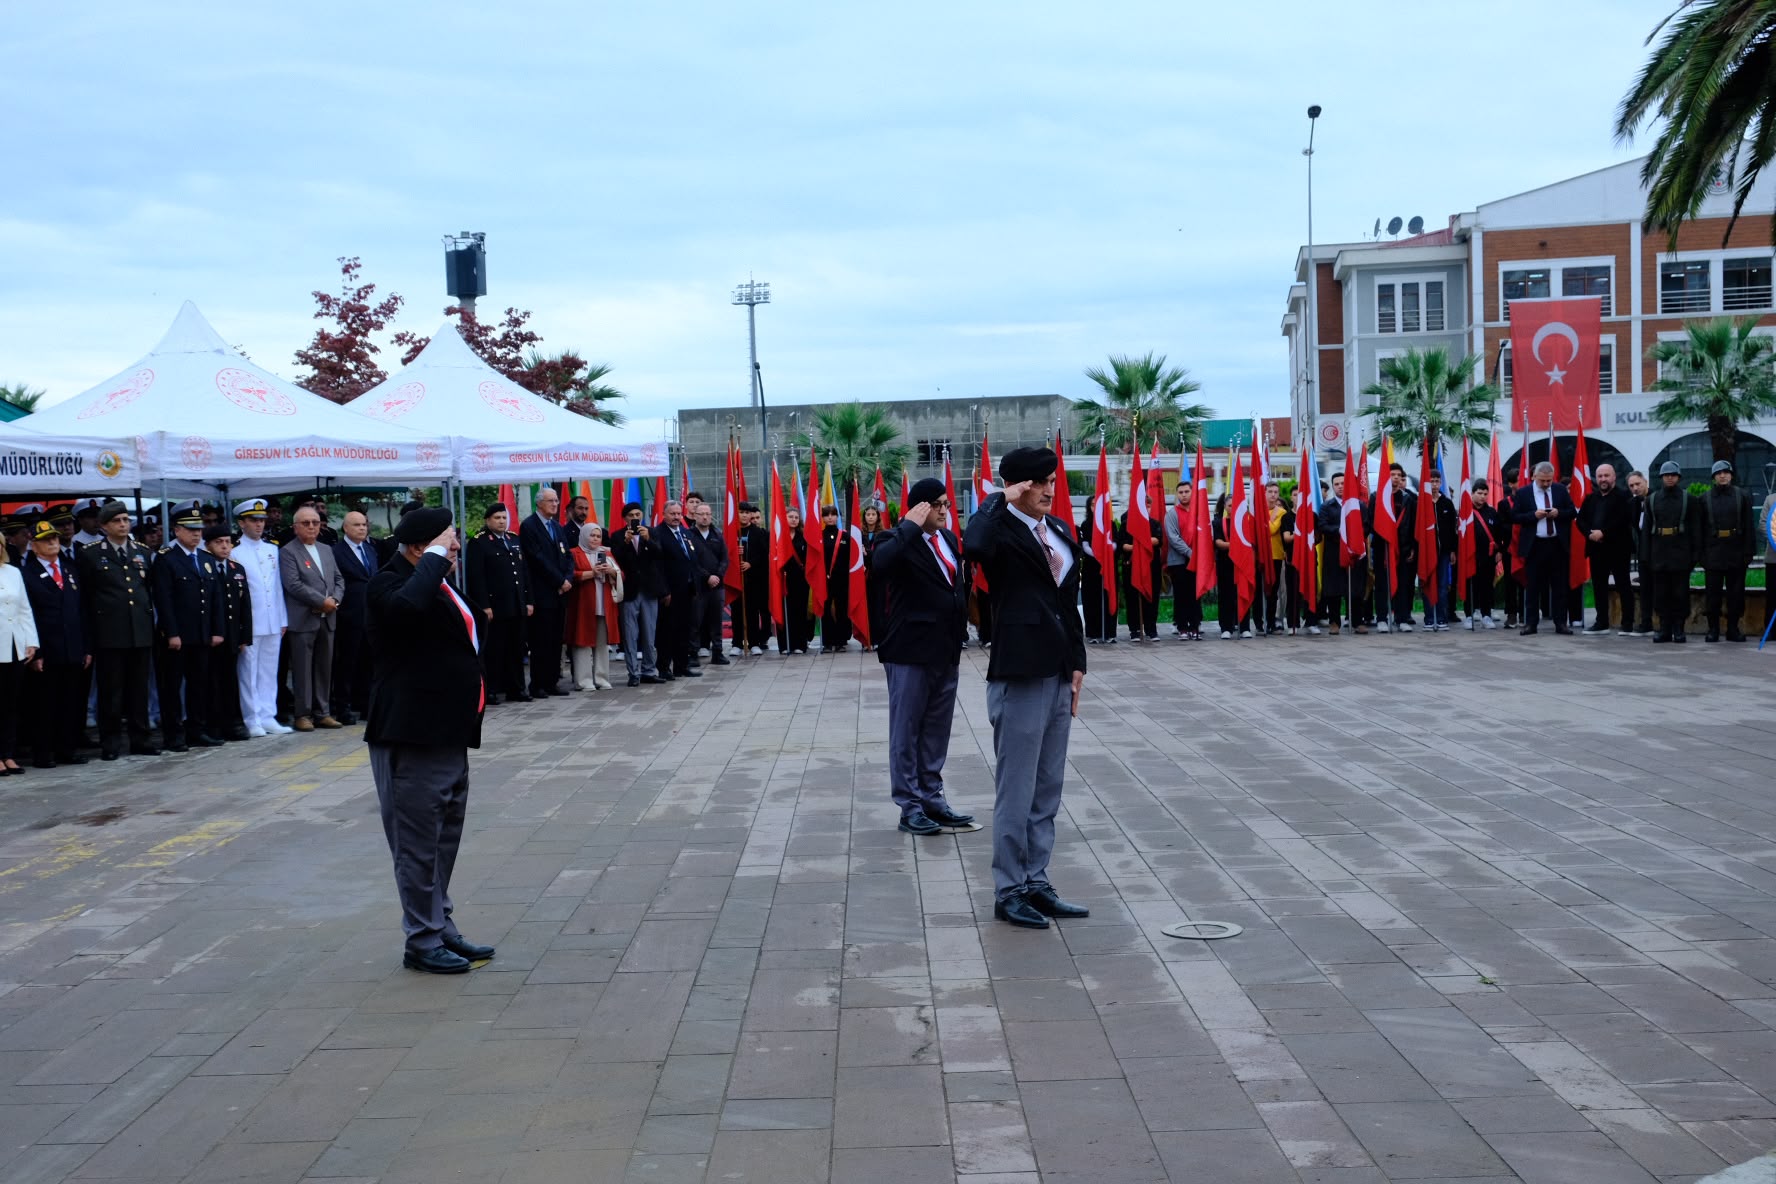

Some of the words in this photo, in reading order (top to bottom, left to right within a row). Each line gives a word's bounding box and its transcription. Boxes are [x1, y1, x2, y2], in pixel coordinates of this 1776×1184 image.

[234, 446, 281, 460] GİRESUN
[283, 445, 292, 459] İL
[294, 444, 332, 459] SAĞLIK
[334, 445, 398, 460] MÜDÜRLÜĞÜ
[509, 452, 544, 464] GİRESUN
[553, 450, 580, 463] SAĞLIK
[582, 451, 629, 463] MÜDÜRLÜĞÜ
